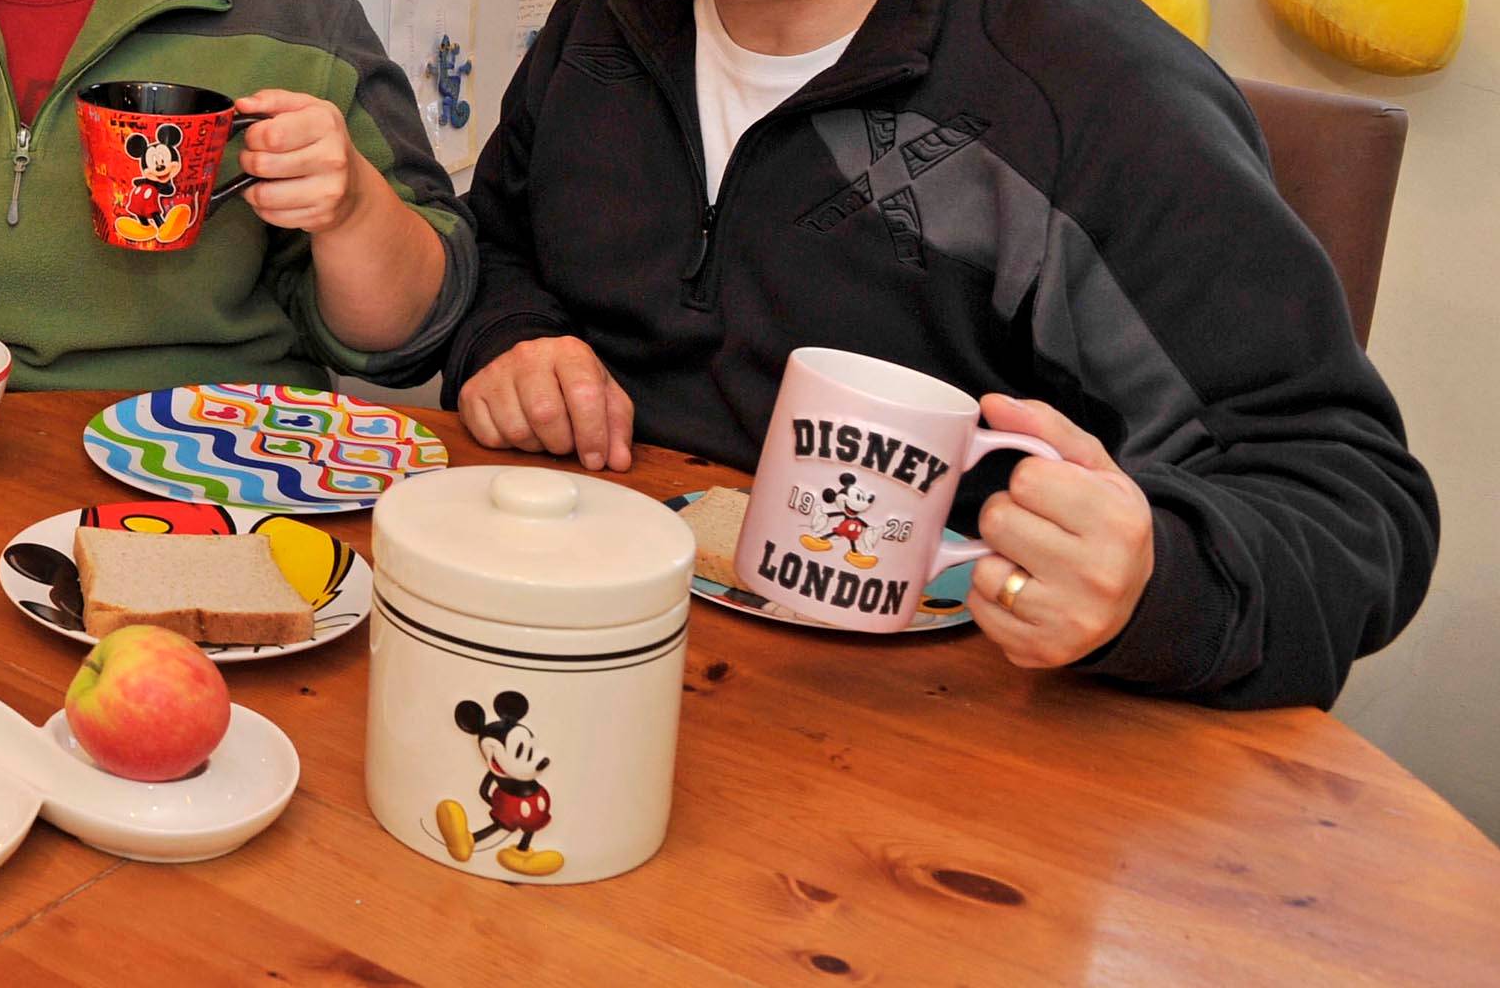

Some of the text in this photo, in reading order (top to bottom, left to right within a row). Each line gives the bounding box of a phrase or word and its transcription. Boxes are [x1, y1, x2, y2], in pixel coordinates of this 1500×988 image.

[186, 118, 214, 180] Mickey
[792, 418, 950, 494] DISNEY
[788, 485, 816, 516] 19
[757, 540, 910, 616] LONDON
